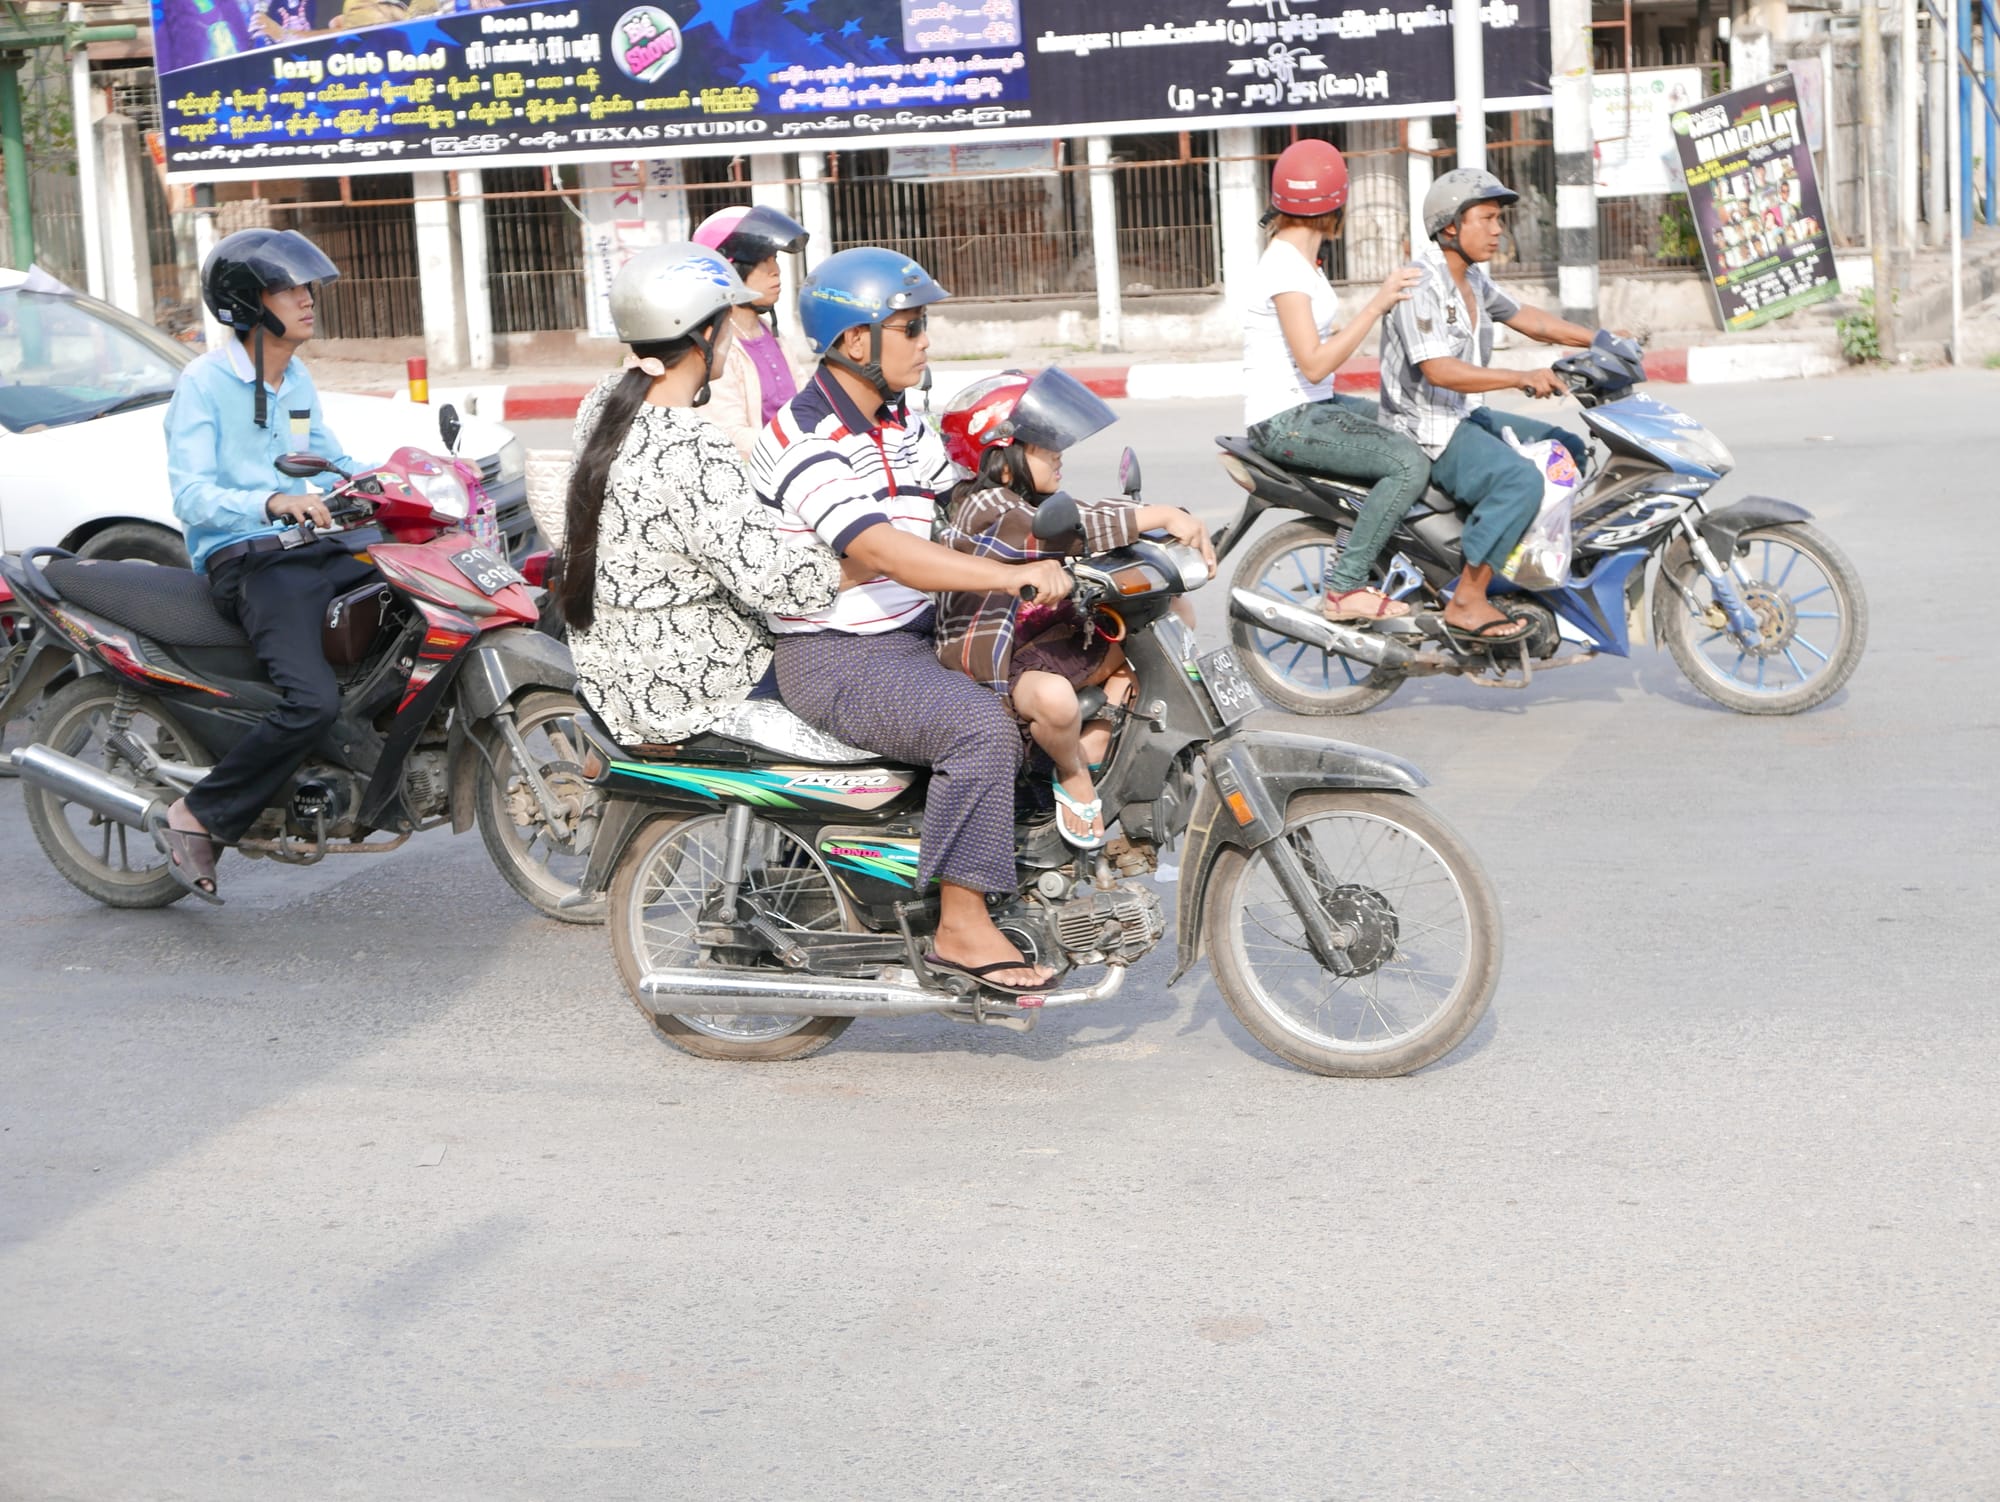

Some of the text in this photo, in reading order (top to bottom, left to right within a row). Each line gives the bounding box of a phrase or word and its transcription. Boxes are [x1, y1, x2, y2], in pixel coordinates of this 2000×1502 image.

[326, 50, 384, 77] Club
[387, 47, 446, 72] Band
[571, 119, 768, 144] TEXAS STUDIO
[1695, 103, 1802, 163] MANDALAY
[830, 846, 883, 859] HONDA
